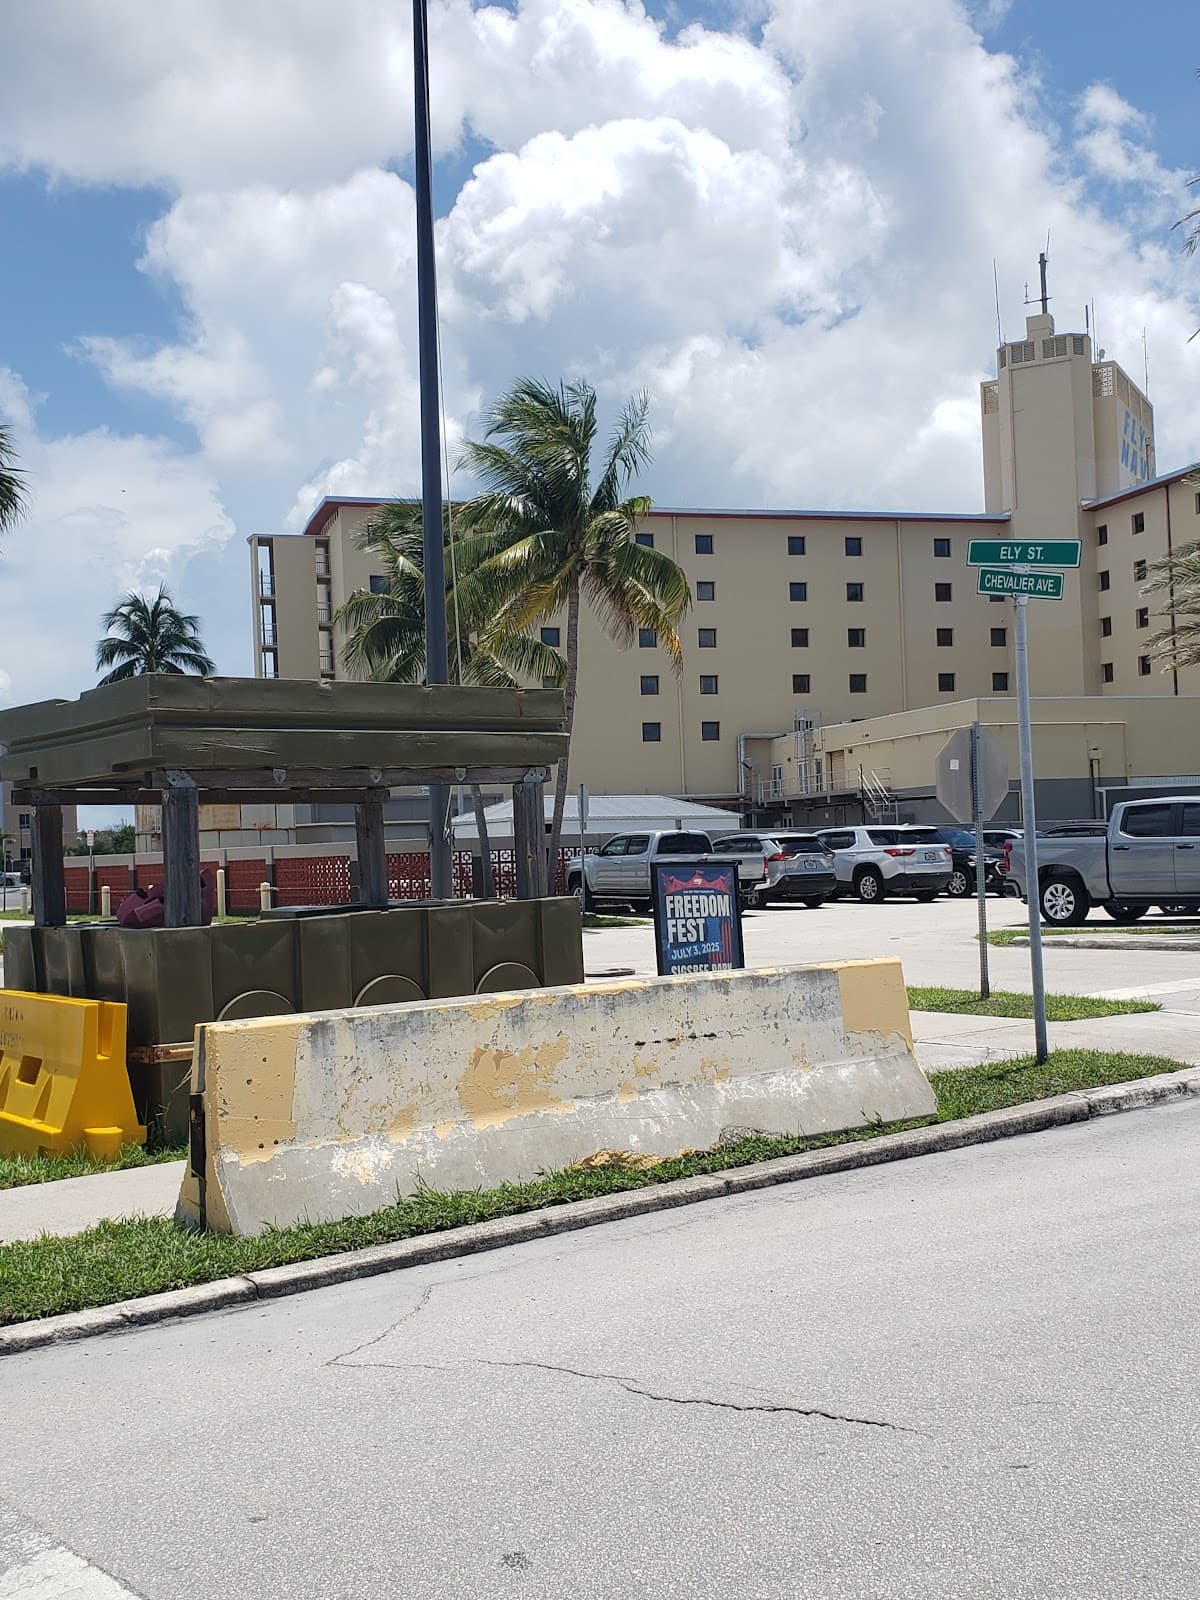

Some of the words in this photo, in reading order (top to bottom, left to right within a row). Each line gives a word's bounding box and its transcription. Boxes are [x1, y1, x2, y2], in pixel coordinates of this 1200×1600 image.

[1000, 546, 1022, 560] ELY
[1027, 546, 1045, 560] ST.
[984, 574, 1035, 591] CHEVALIER
[1036, 578, 1057, 593] AVE.
[666, 895, 730, 918] FREEDOM
[668, 919, 705, 943] FEST
[672, 947, 692, 960] JULY
[701, 943, 720, 954] 2025
